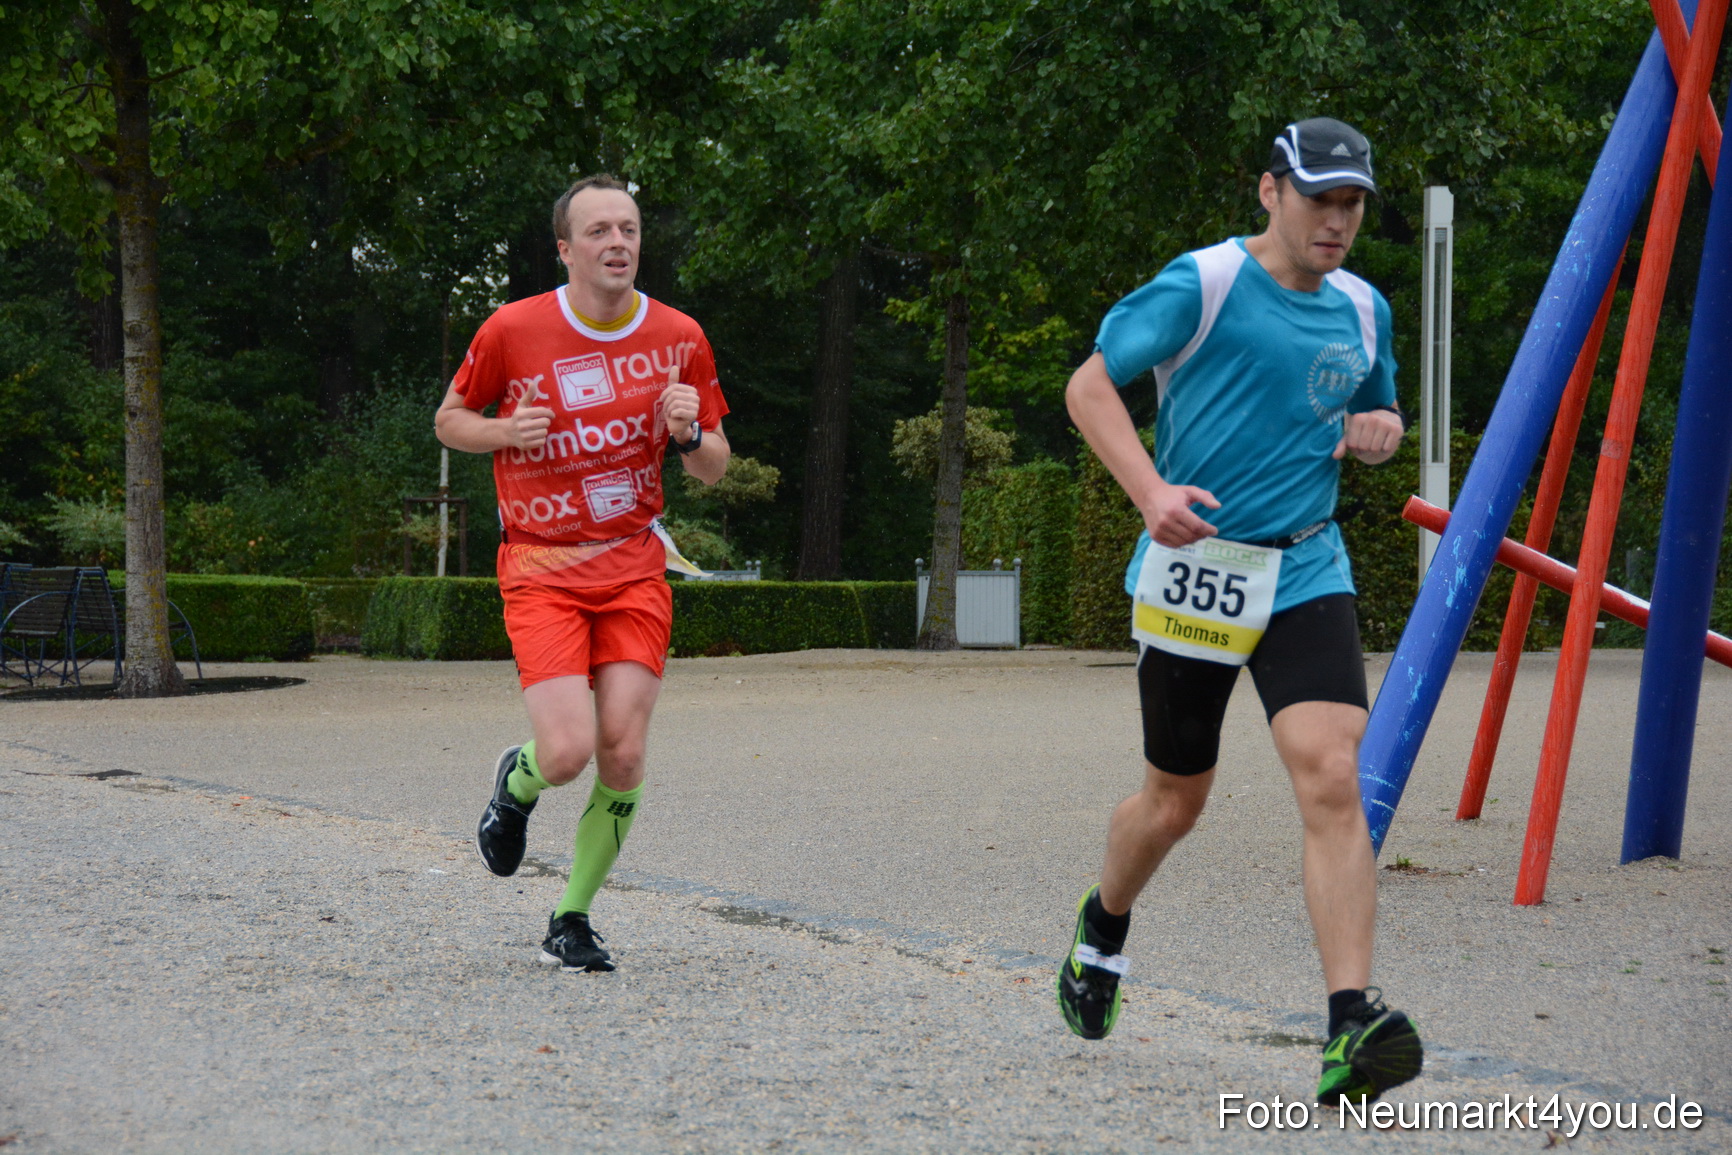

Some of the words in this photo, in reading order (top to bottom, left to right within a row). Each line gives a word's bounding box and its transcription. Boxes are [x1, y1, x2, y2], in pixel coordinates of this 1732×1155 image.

[558, 358, 603, 375] raumbox
[553, 457, 601, 475] wohnen
[586, 472, 629, 491] raumbox
[1163, 561, 1248, 618] 355
[1164, 616, 1230, 647] Thomas
